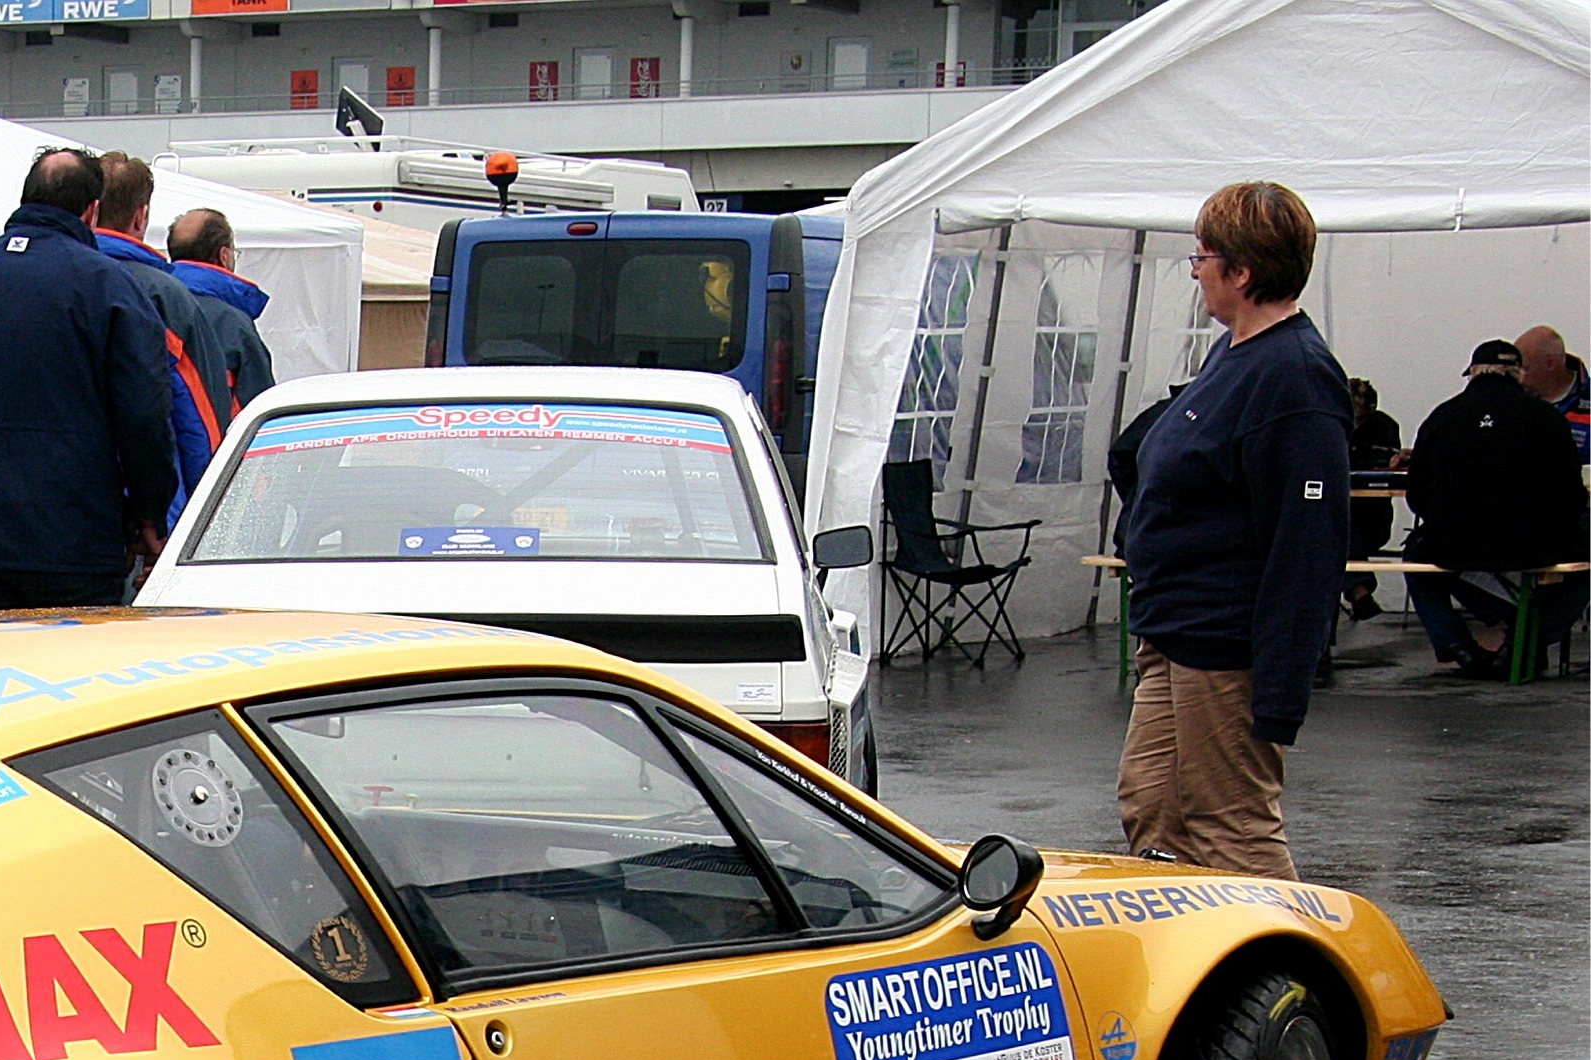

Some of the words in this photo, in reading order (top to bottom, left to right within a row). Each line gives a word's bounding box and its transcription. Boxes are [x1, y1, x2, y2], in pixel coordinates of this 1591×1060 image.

[63, 1, 119, 18] RWE
[414, 405, 563, 430] Speedy
[285, 437, 344, 451] BANDEN
[350, 434, 383, 445] APK
[386, 428, 480, 441] ONDERHOUD
[486, 428, 555, 438] UITLATEN
[562, 431, 626, 442] REMMEN
[1042, 884, 1341, 929] NETSERVICES.NL
[829, 948, 1053, 1027] SMARTOFFICE.NL
[976, 995, 1052, 1041] Trophy
[1035, 1042, 1063, 1056] KOSTER
